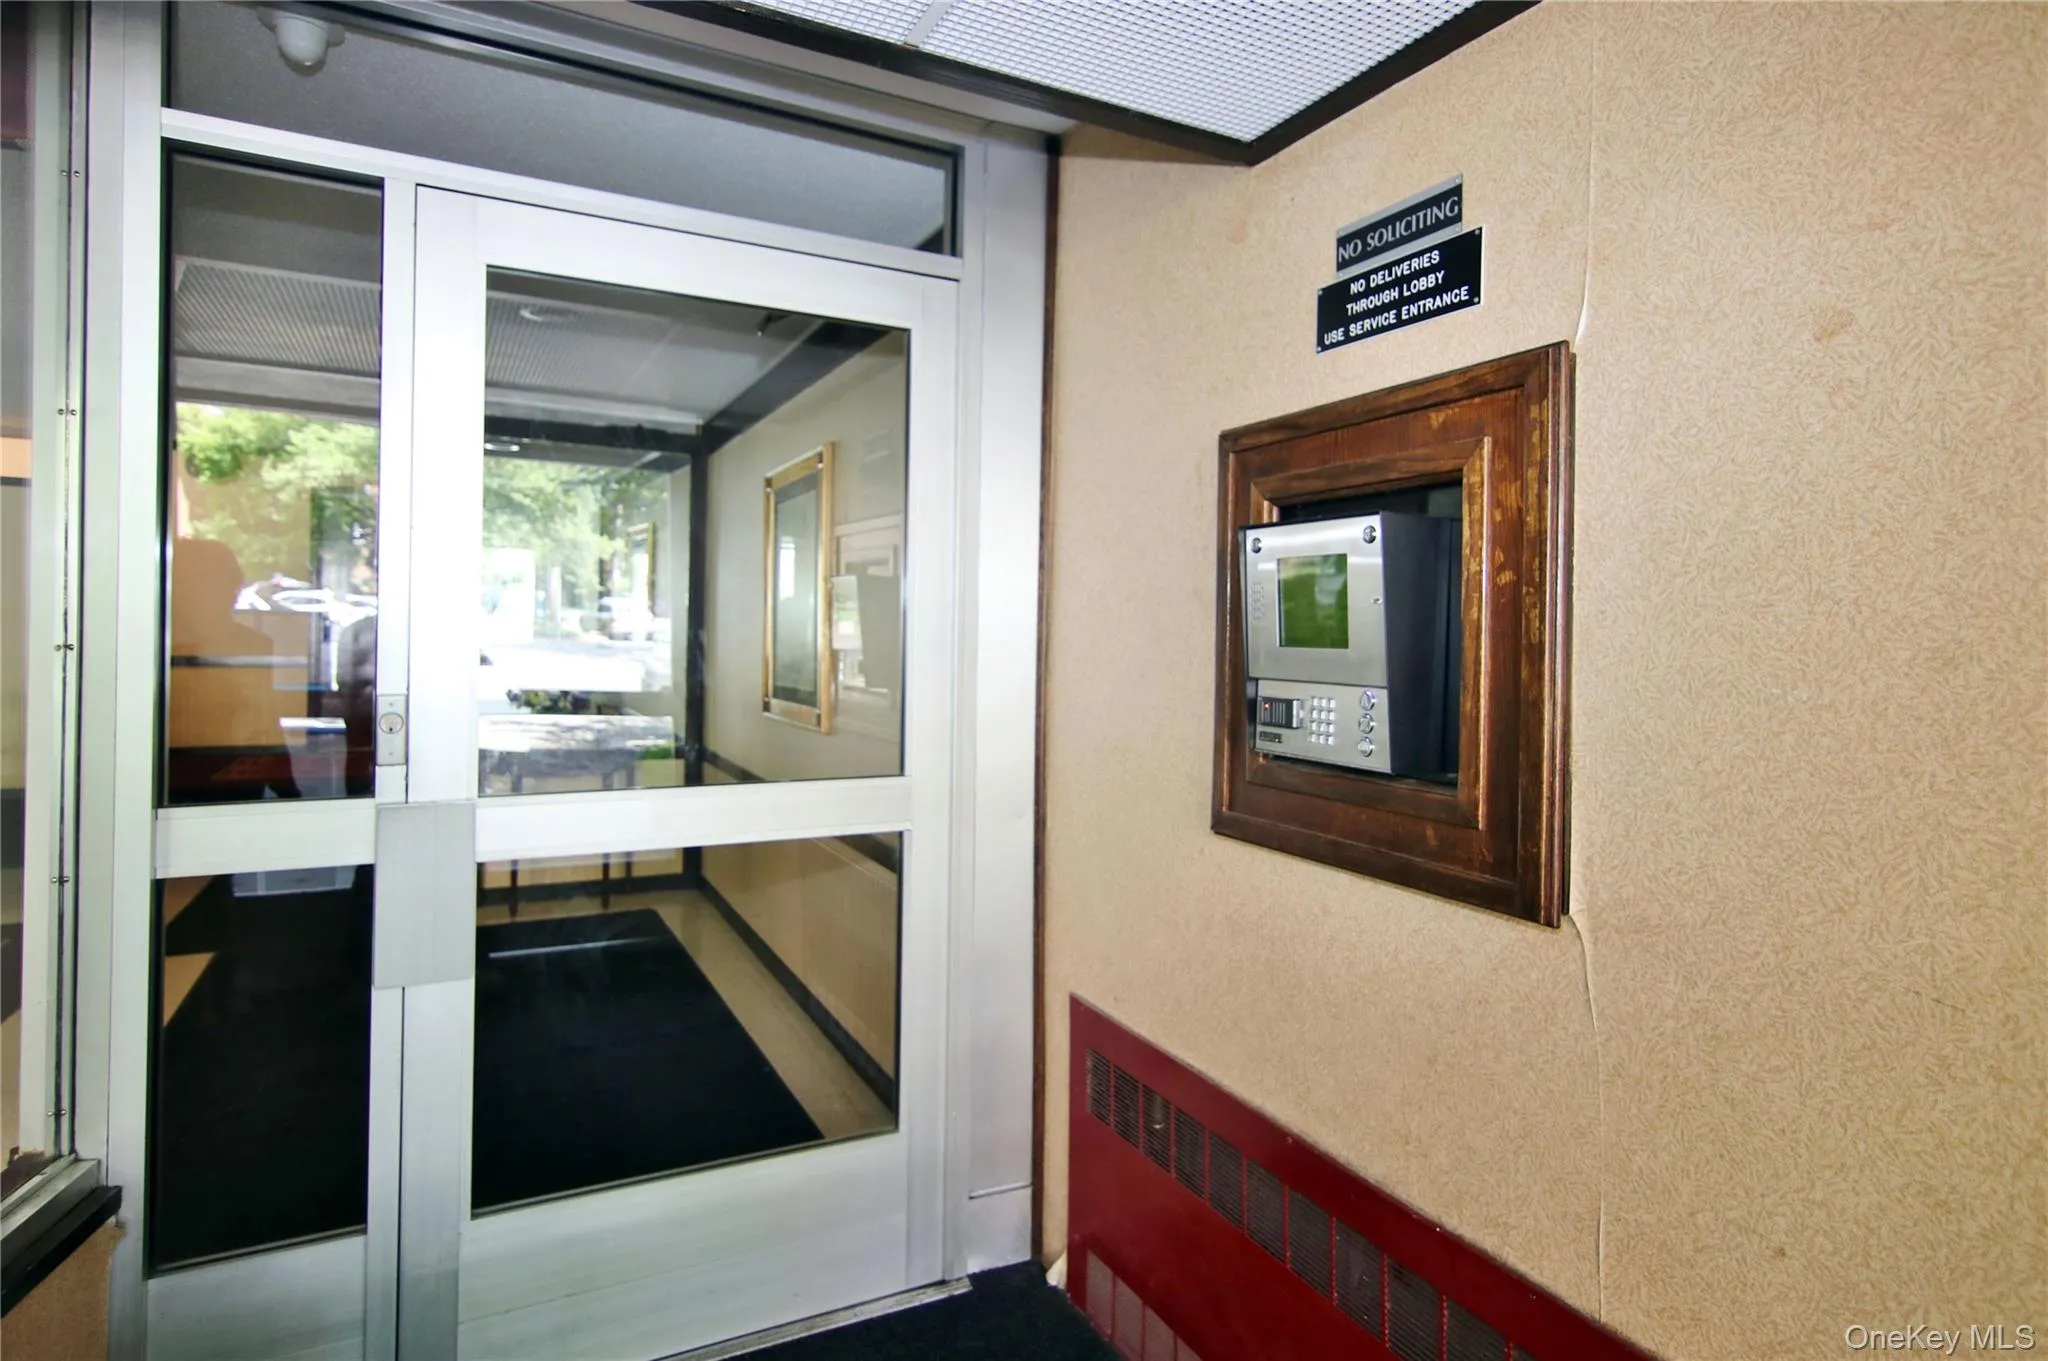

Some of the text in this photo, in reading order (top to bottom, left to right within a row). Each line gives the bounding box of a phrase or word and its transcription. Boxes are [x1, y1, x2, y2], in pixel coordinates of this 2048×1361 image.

[1338, 196, 1459, 263] NO SOLICITING
[1346, 270, 1445, 316] THROUGH LOBBY
[1350, 250, 1440, 295] NO DELIVERIES
[1324, 286, 1470, 345] USE SERVICE ENTRANCE
